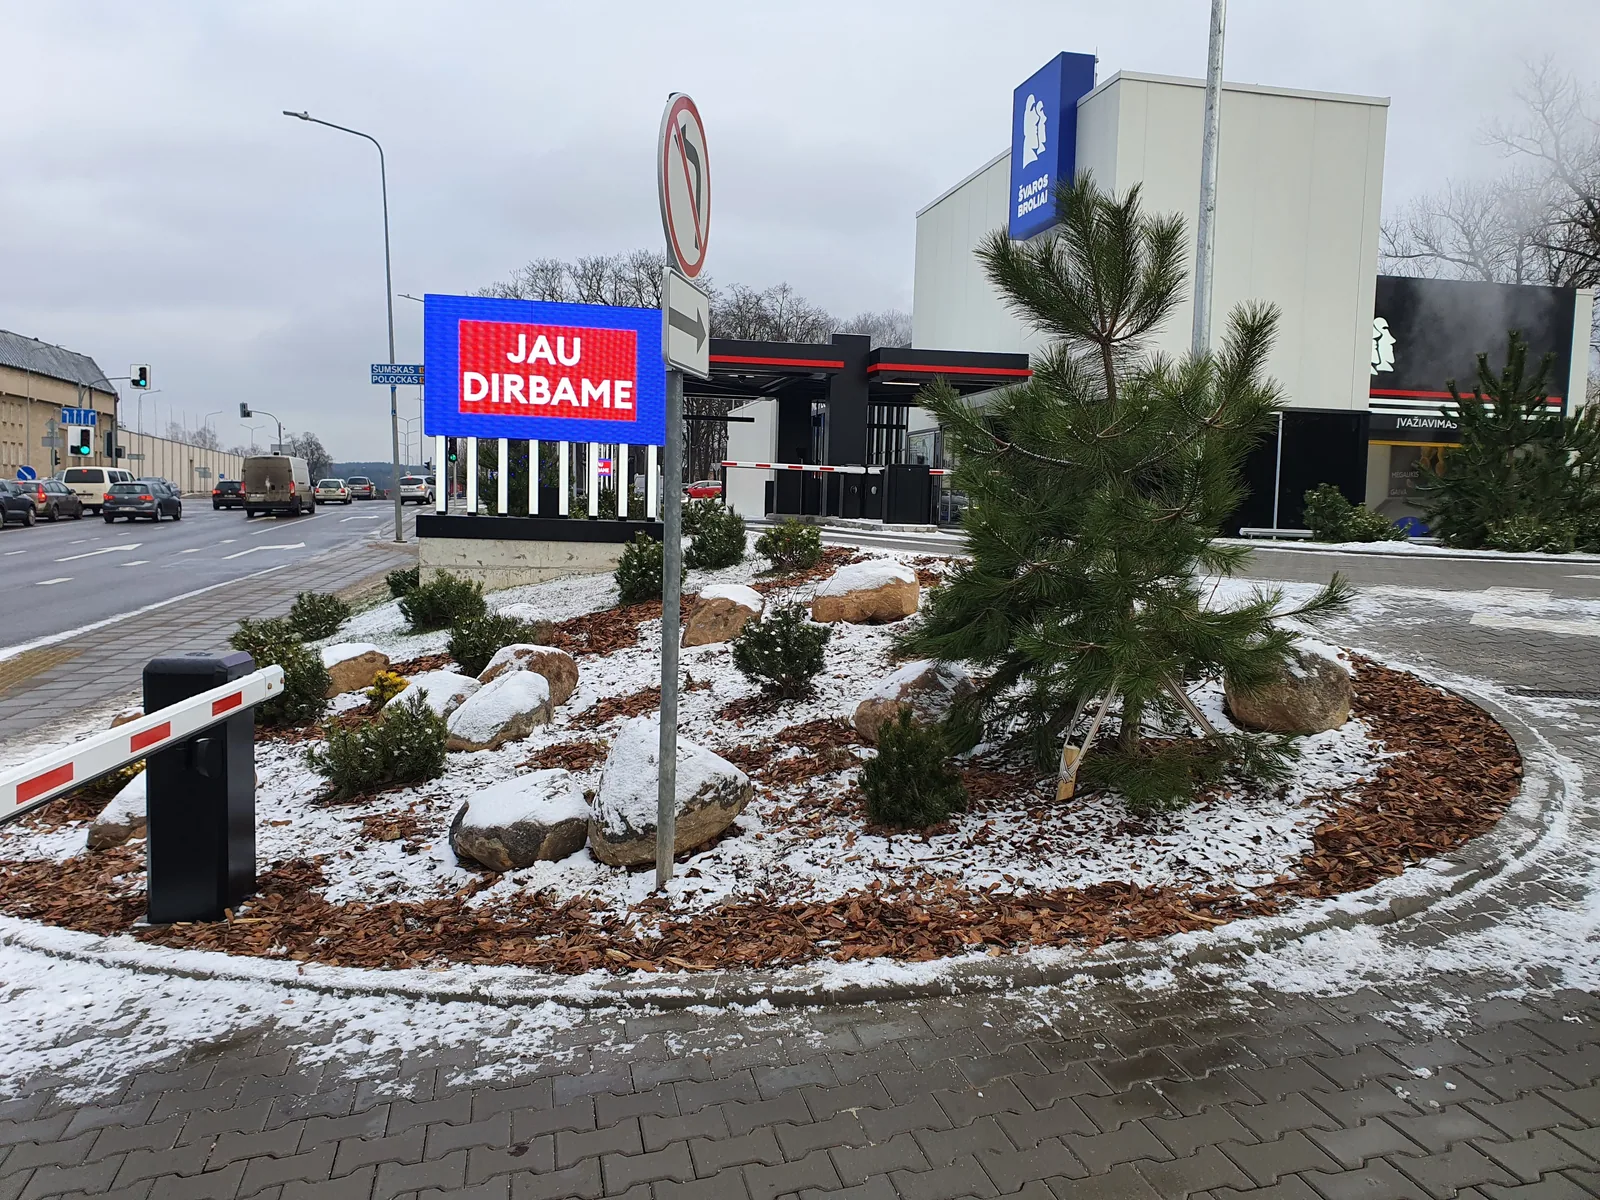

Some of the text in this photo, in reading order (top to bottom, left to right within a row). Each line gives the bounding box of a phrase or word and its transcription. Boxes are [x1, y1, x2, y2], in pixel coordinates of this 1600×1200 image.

[1018, 173, 1049, 202] ŠVAROS
[1017, 189, 1048, 218] BROLIAI
[506, 333, 581, 367] JAU
[372, 364, 415, 374] ŠUMSKAS
[372, 375, 418, 384] POLOCKAS
[463, 371, 633, 410] DIRBAME
